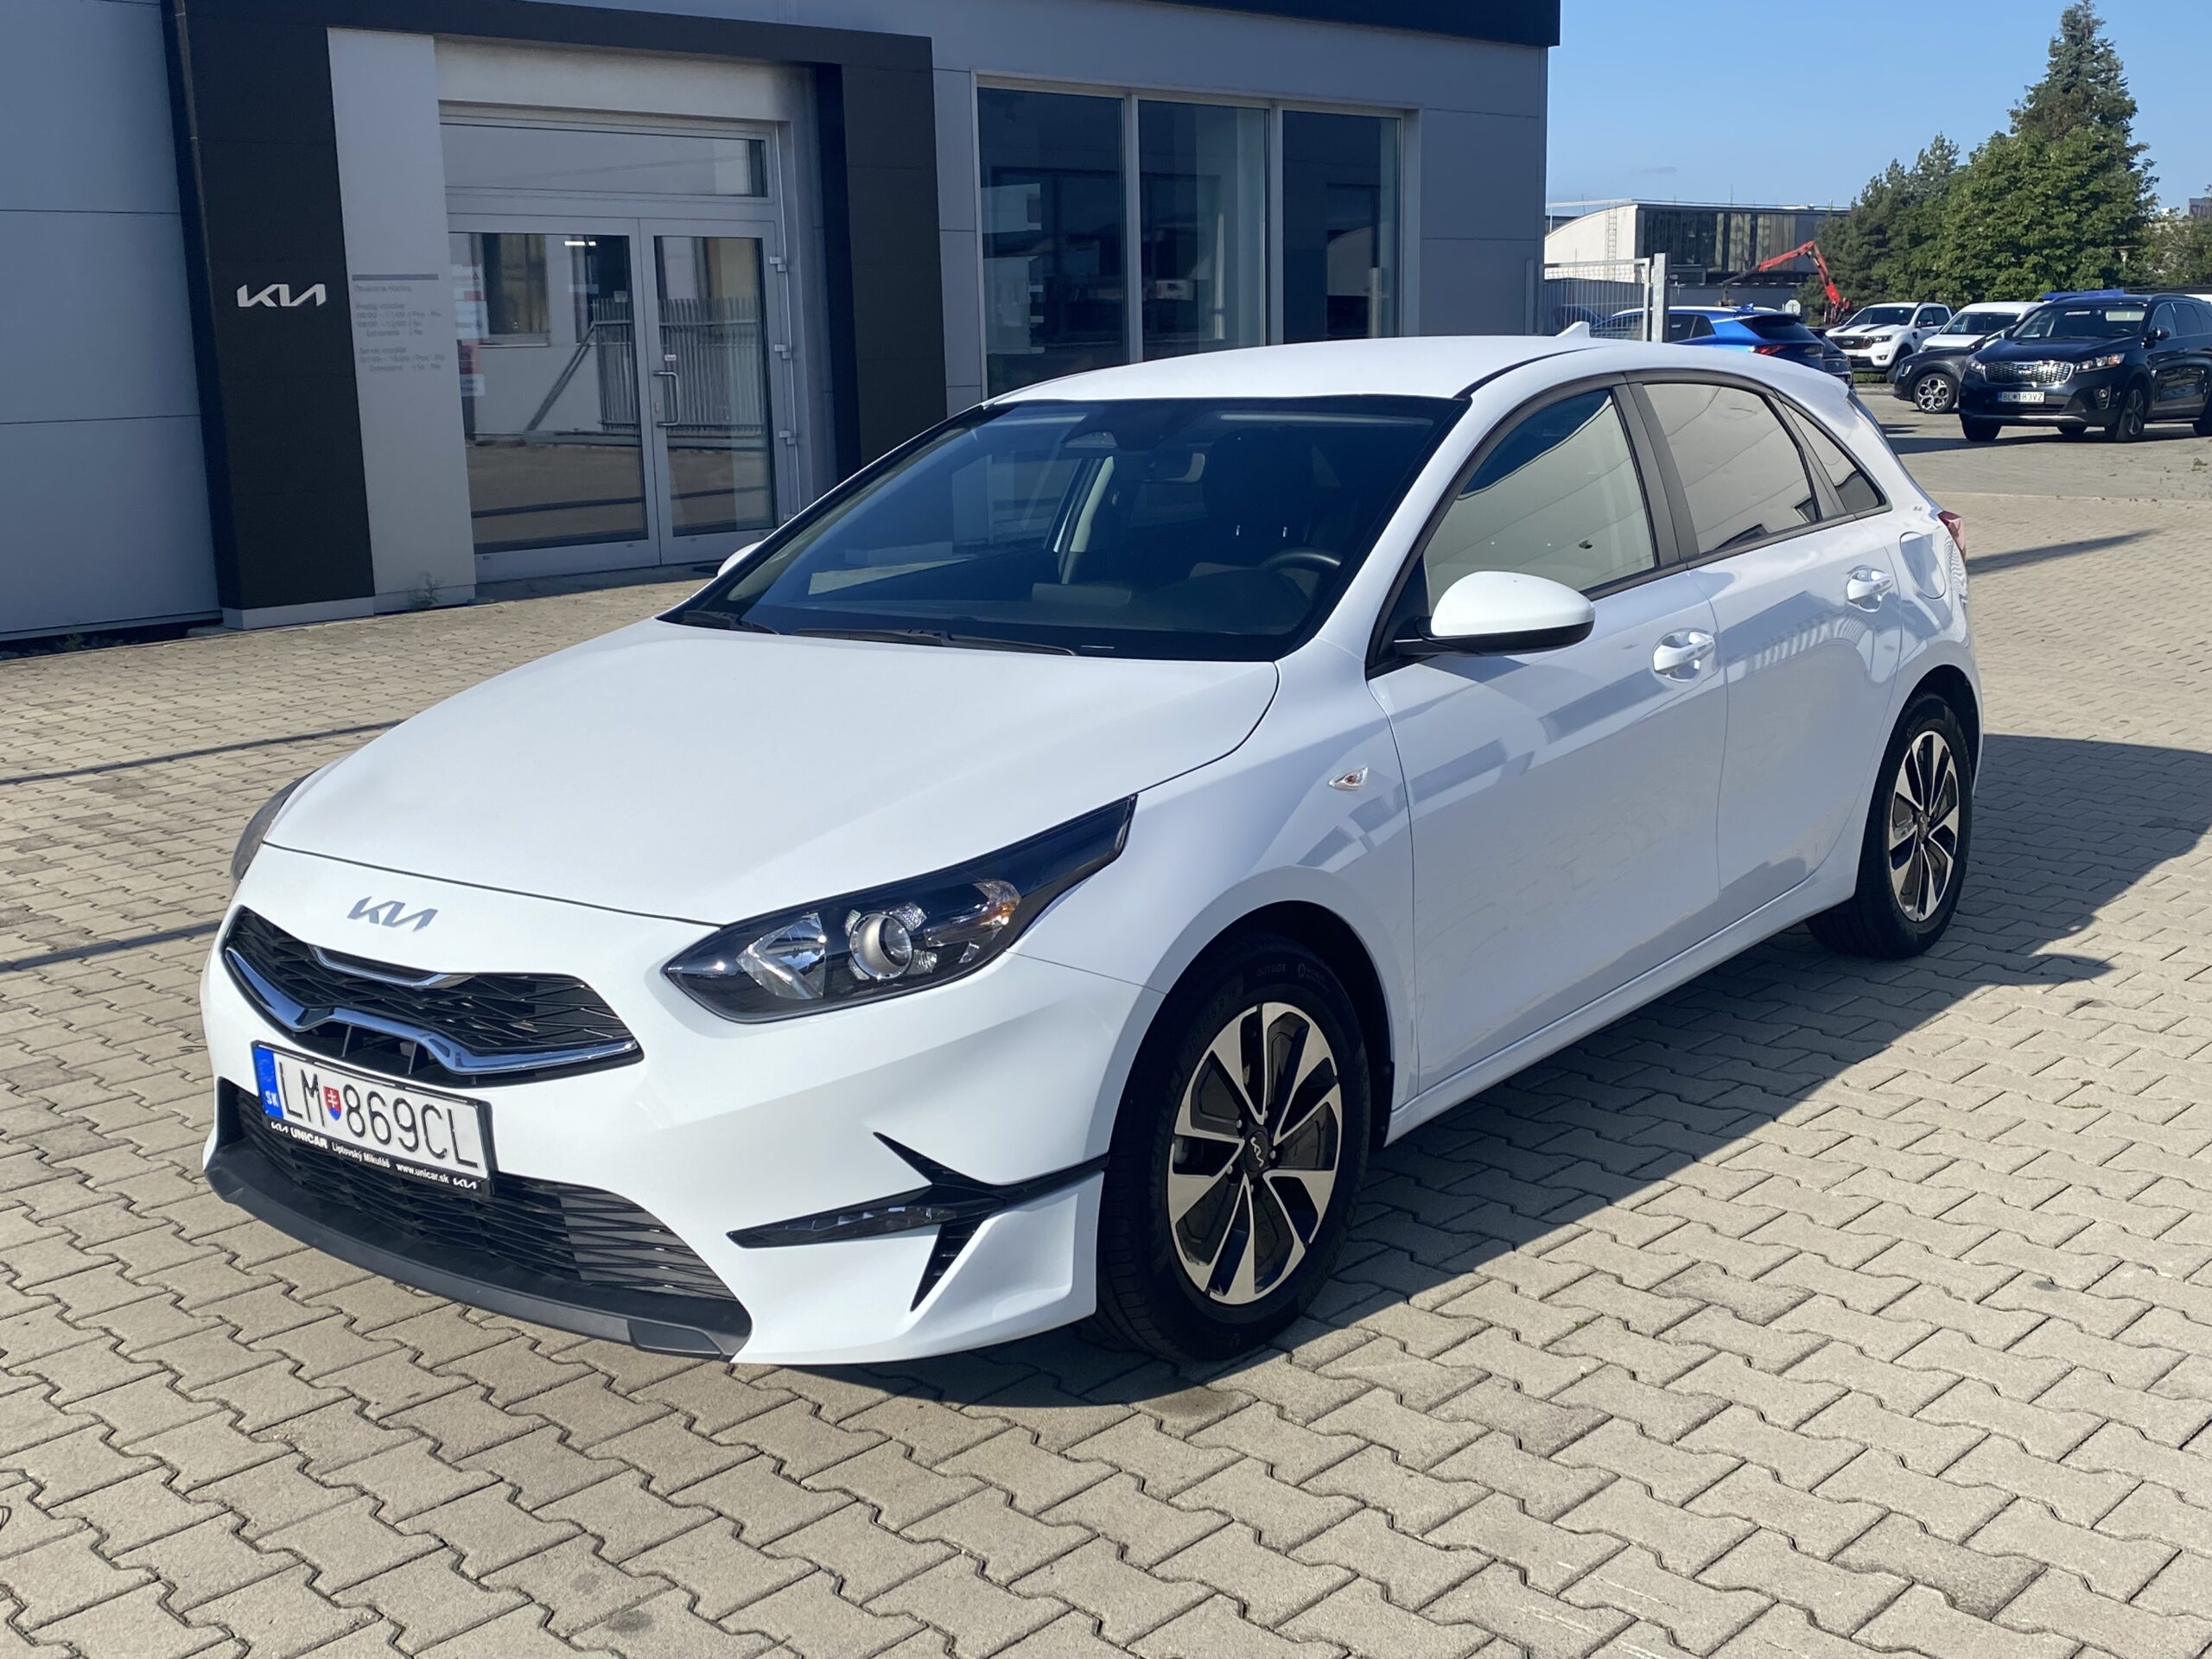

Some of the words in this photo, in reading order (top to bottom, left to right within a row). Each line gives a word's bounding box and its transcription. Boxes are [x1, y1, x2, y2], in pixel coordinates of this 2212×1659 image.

[237, 283, 327, 307] KIA
[346, 896, 438, 932] KIA
[265, 1090, 279, 1108] SK
[289, 1127, 327, 1149] UNICAR
[332, 1141, 363, 1162] Liptovský
[396, 1163, 449, 1185] www.unicar.sk
[452, 1177, 477, 1190] KIA
